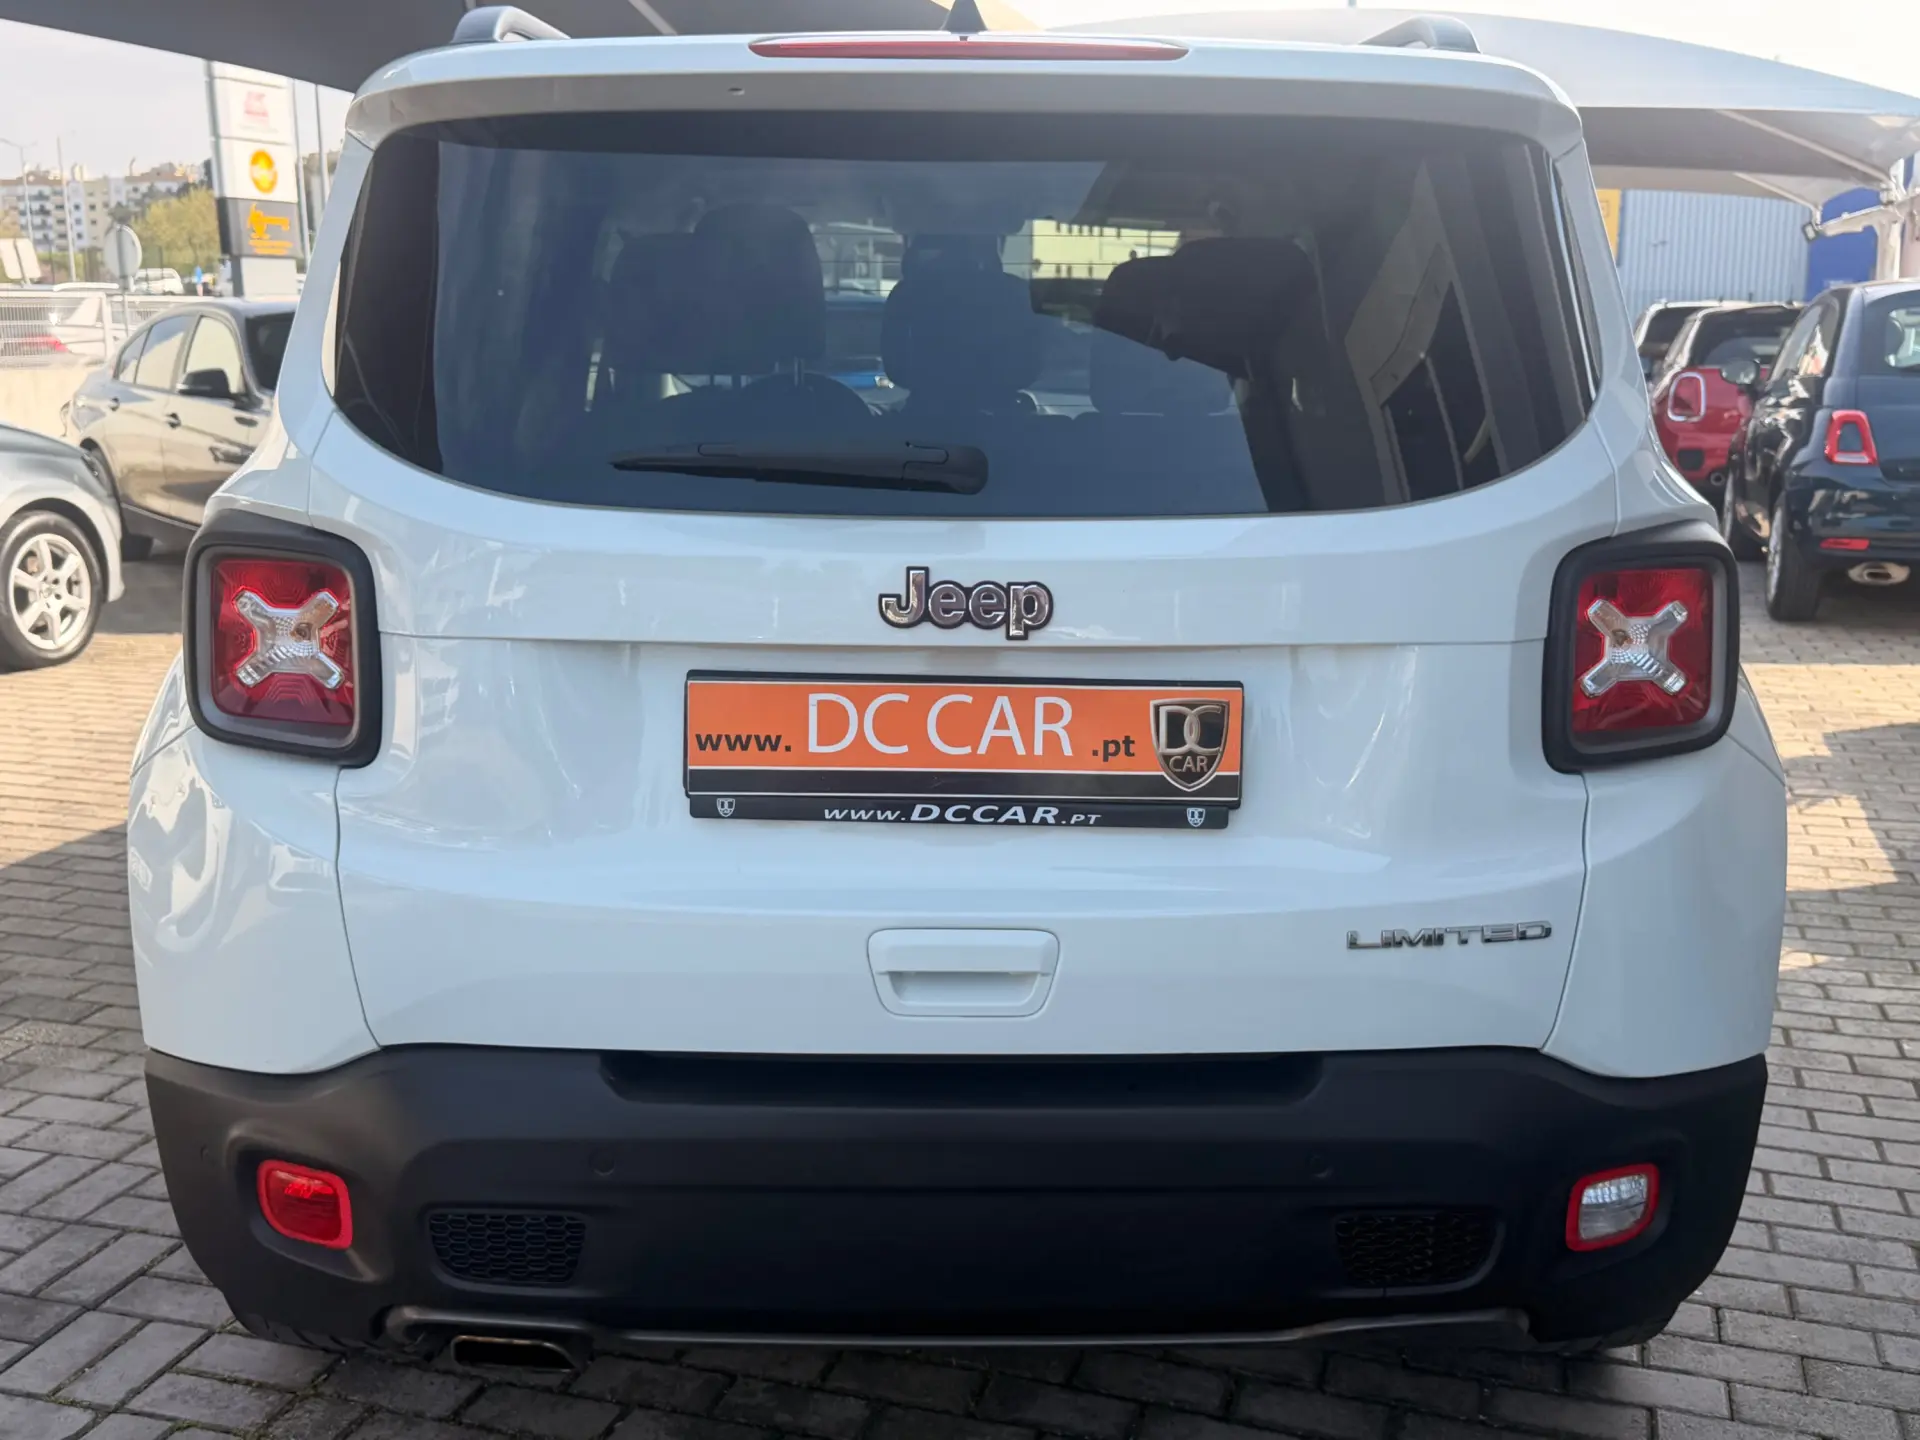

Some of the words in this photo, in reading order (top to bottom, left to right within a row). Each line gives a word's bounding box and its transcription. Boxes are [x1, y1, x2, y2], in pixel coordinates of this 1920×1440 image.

[879, 566, 1054, 640] Jeep
[695, 733, 791, 752] www.
[926, 695, 1074, 757] CAR
[1092, 736, 1136, 762] .pt
[1169, 756, 1208, 772] CAR
[1347, 921, 1552, 949] LIMITED
